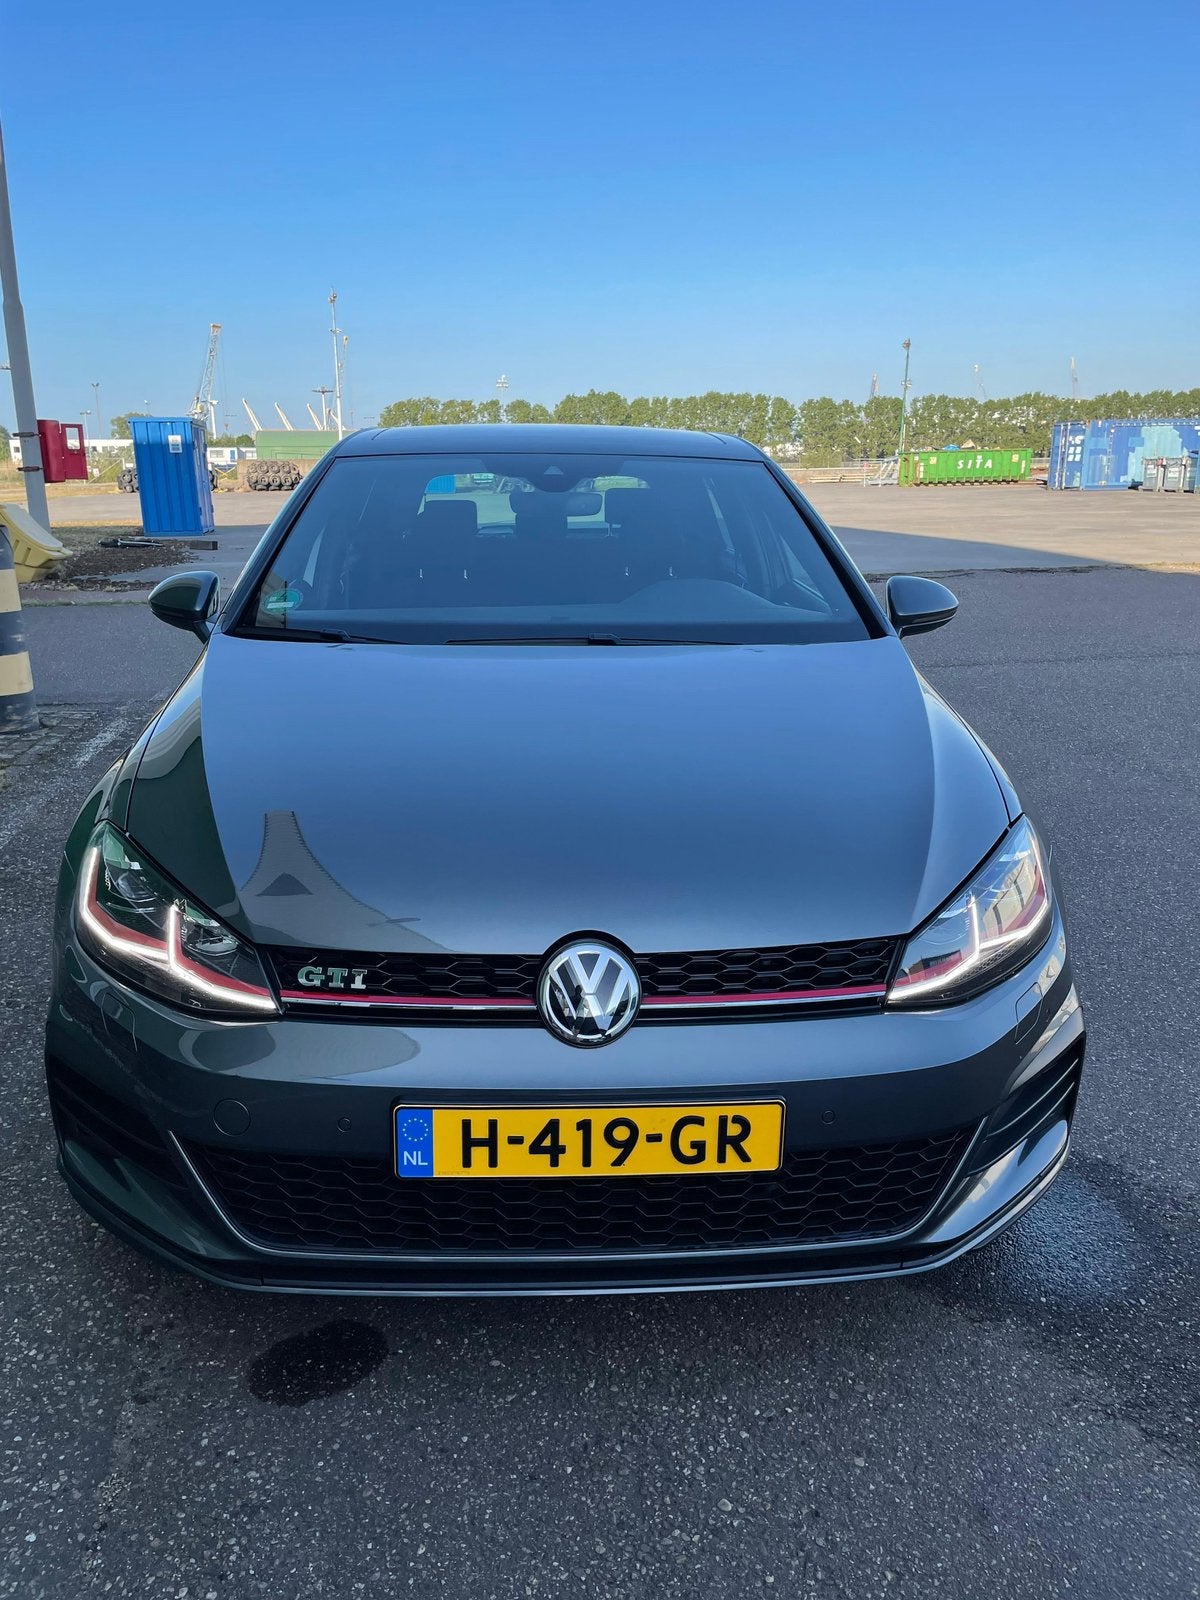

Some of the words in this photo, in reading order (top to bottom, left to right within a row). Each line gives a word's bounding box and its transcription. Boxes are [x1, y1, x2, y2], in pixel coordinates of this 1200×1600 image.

[957, 459, 993, 469] SITA
[298, 966, 368, 989] GTI
[461, 1115, 752, 1168] H-419-GR
[403, 1151, 429, 1166] NL
